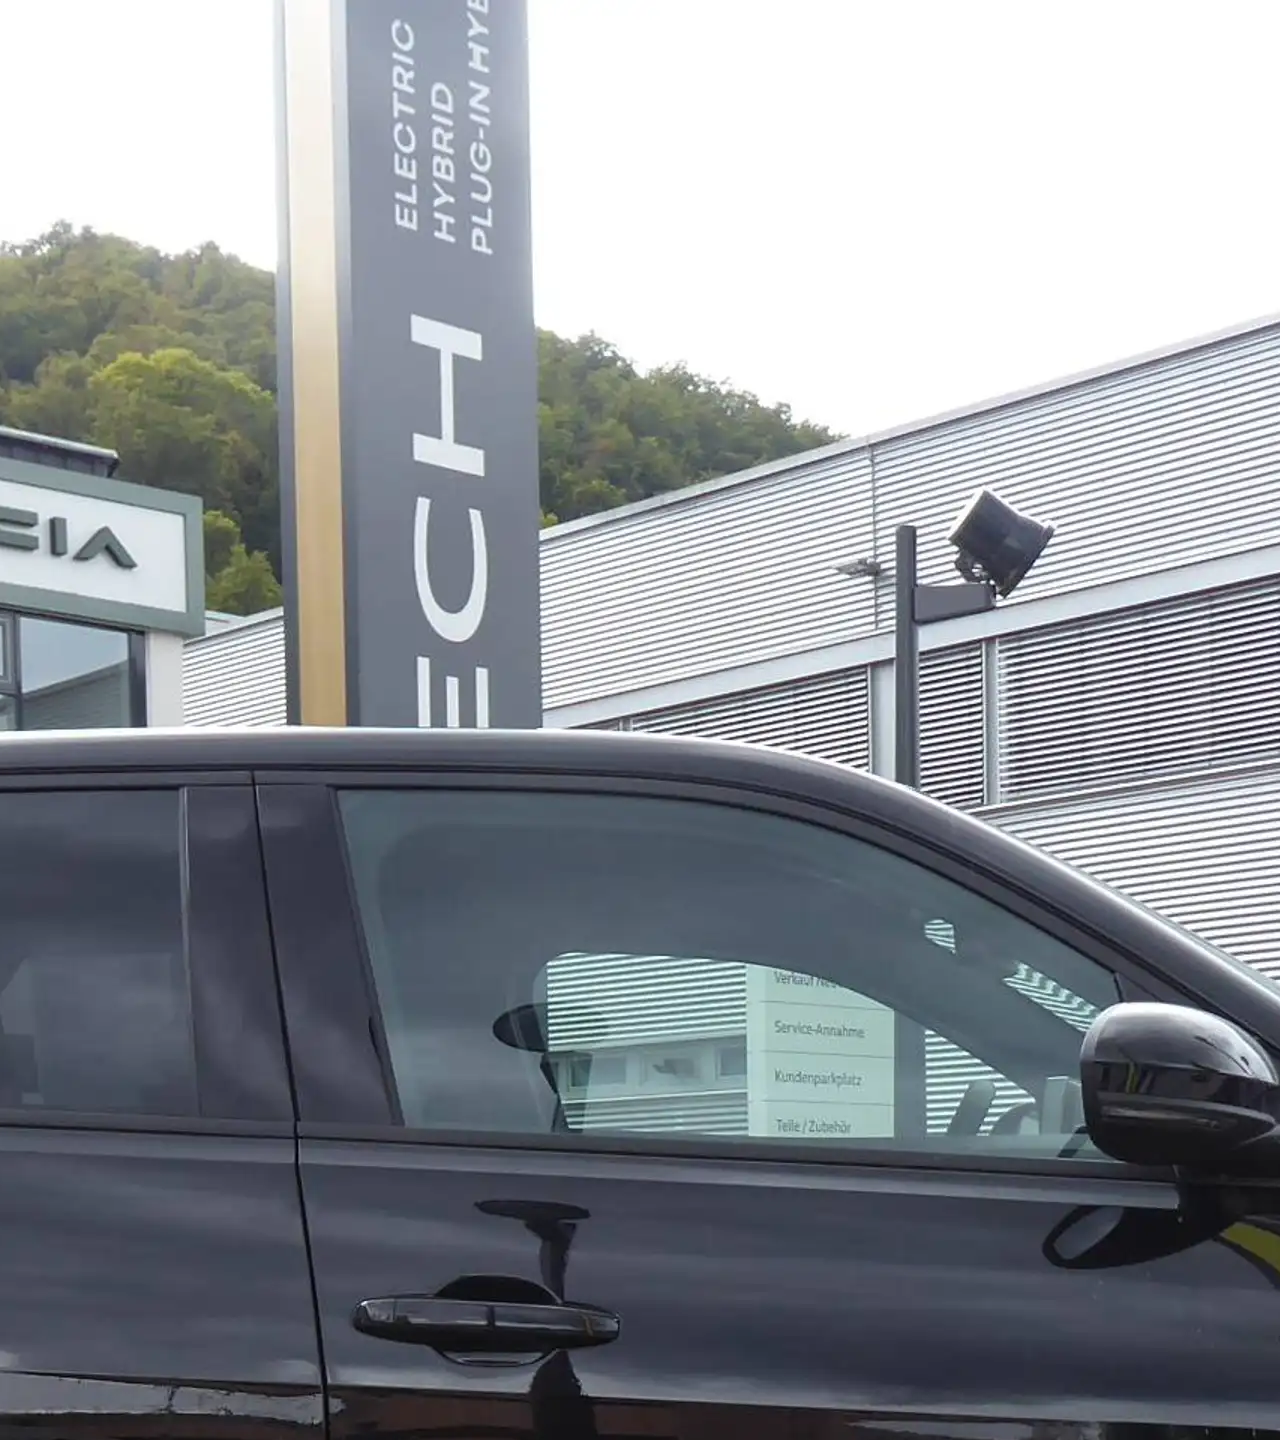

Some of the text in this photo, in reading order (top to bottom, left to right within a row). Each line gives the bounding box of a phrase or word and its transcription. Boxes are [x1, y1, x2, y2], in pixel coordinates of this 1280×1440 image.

[391, 19, 418, 231] ELECTRIC
[431, 82, 456, 243] HYBRID
[468, 80, 494, 255] PLUG-IN
[775, 1020, 865, 1039] Service-Annahme
[775, 1069, 862, 1089] Kundenparkplatz
[777, 1119, 801, 1133] Teile
